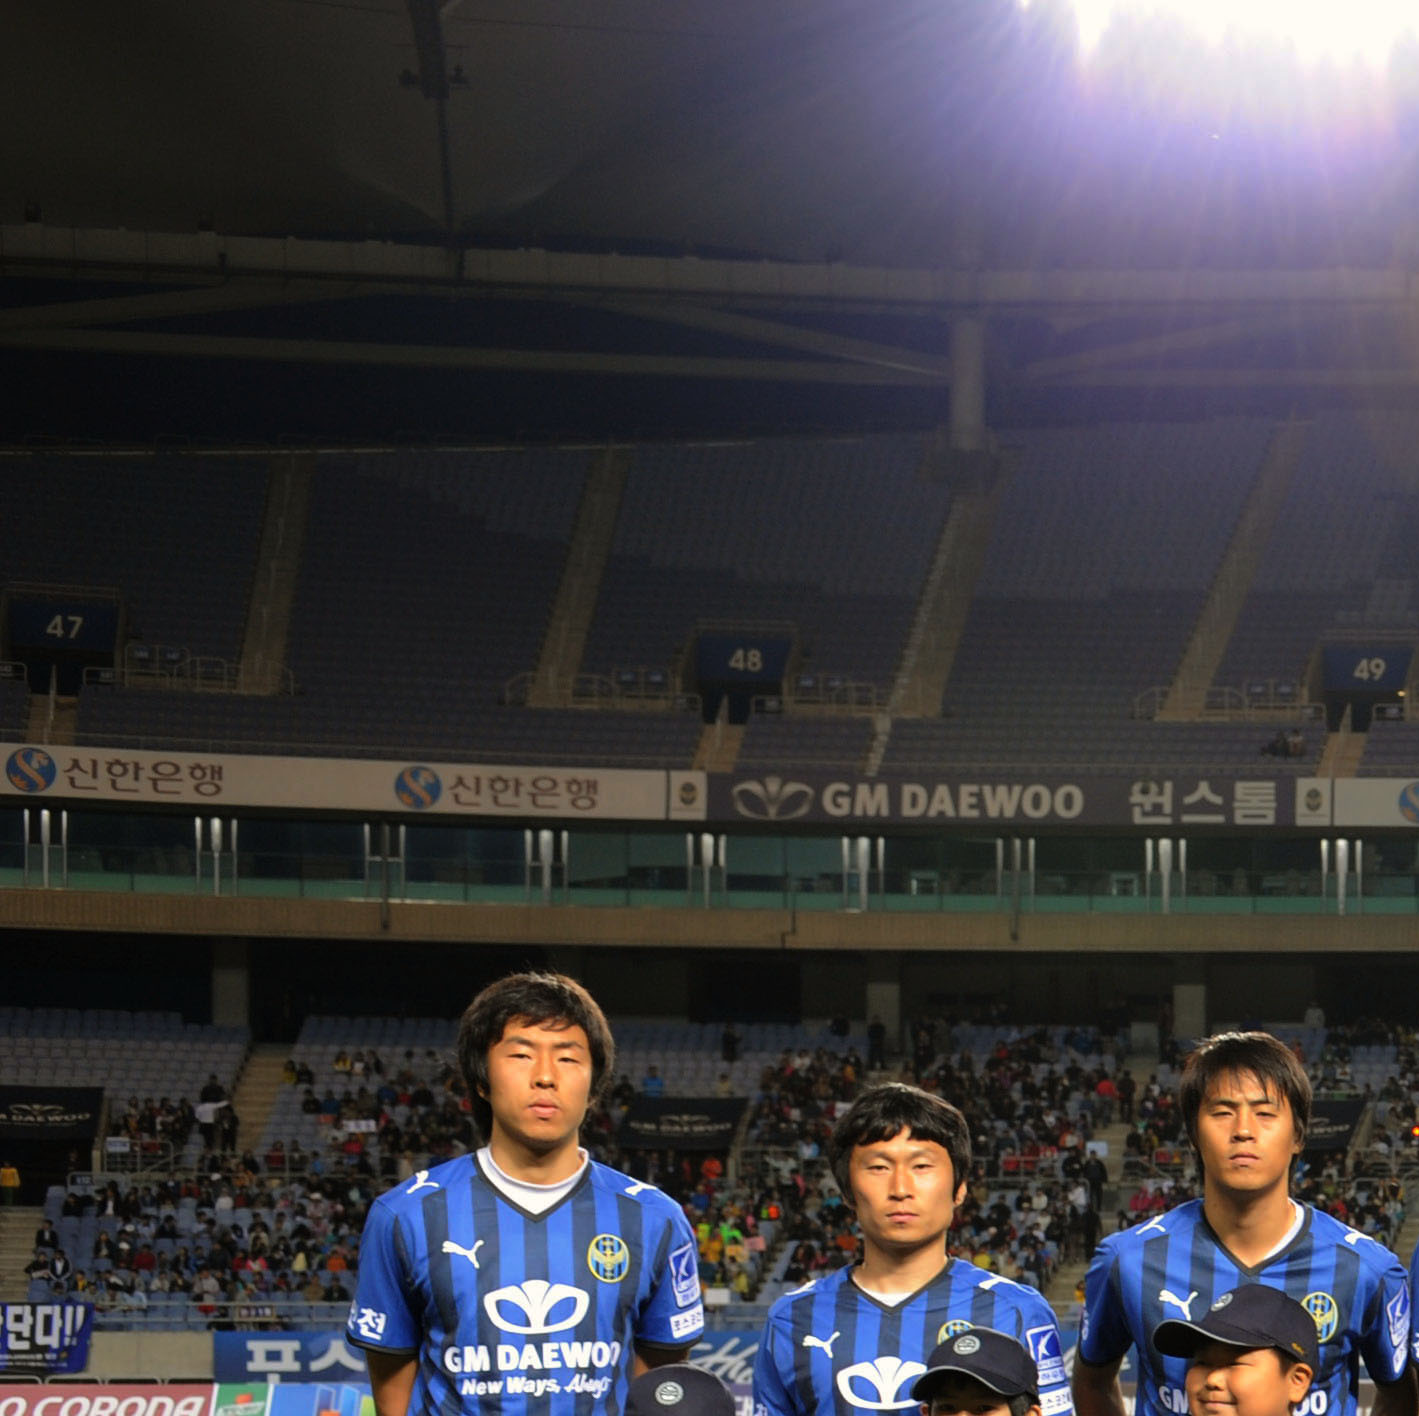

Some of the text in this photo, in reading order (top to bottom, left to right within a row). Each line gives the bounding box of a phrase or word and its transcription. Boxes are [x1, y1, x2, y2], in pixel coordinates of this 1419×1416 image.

[46, 615, 84, 640] 47
[728, 648, 763, 673] 48
[1353, 658, 1386, 682] 49
[63, 758, 224, 797] 신한은행
[449, 775, 599, 810] 신한은행
[821, 780, 1278, 826] GM DAEWOO 원스톰
[0, 1305, 85, 1350] 단다!!
[445, 1341, 621, 1373] GM DAEWOO
[462, 1377, 503, 1396] New
[507, 1376, 560, 1396] Ways,
